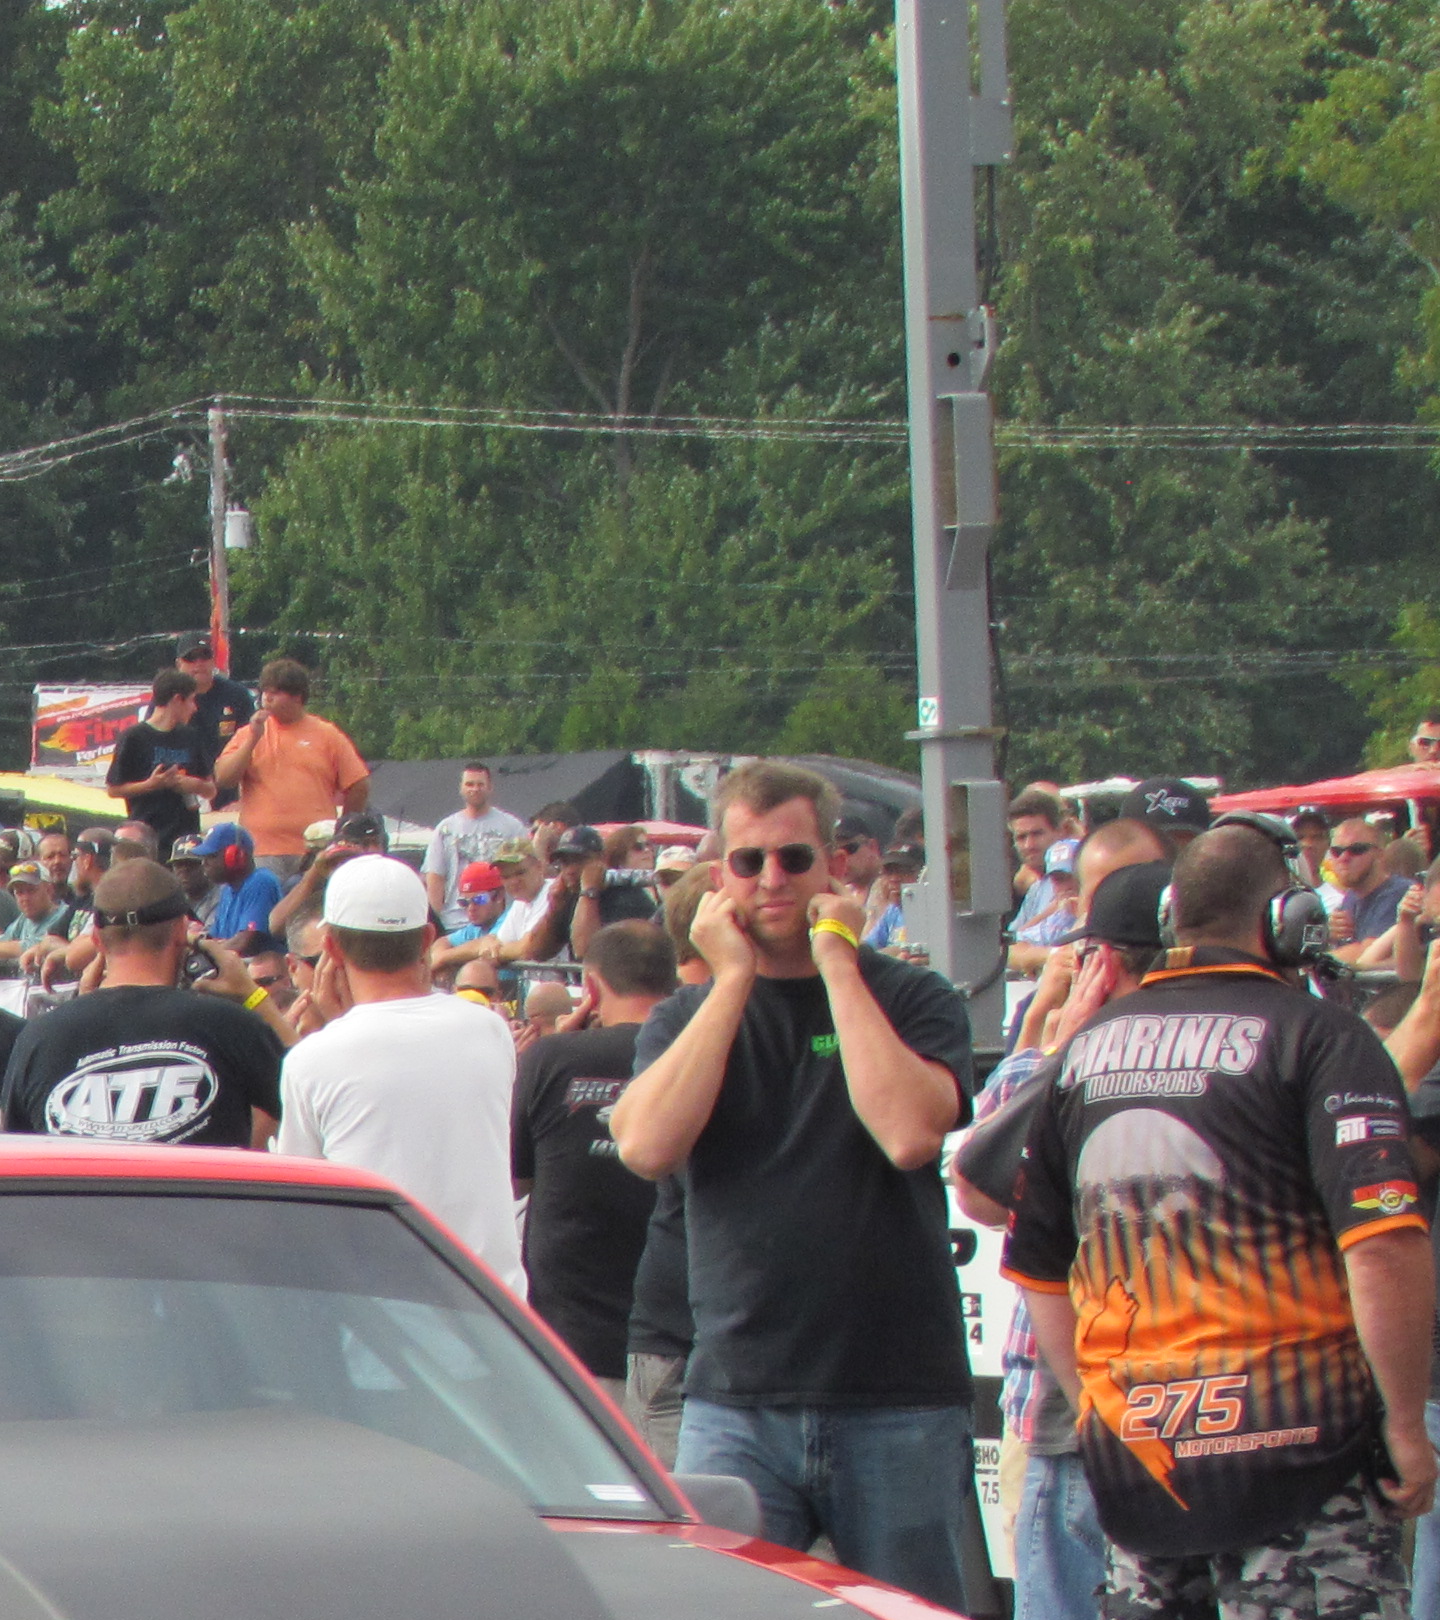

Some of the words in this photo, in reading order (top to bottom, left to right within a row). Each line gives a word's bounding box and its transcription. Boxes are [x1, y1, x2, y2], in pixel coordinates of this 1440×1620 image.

[118, 1040, 178, 1056] Transmission
[178, 1040, 208, 1060] Factory
[1058, 1014, 1267, 1092] MARINIS
[63, 1064, 207, 1124] ATF
[1086, 1070, 1209, 1103] MOTORSPORTS
[1120, 1374, 1249, 1442] 275
[1174, 1426, 1319, 1459] MOTORSPORTS
